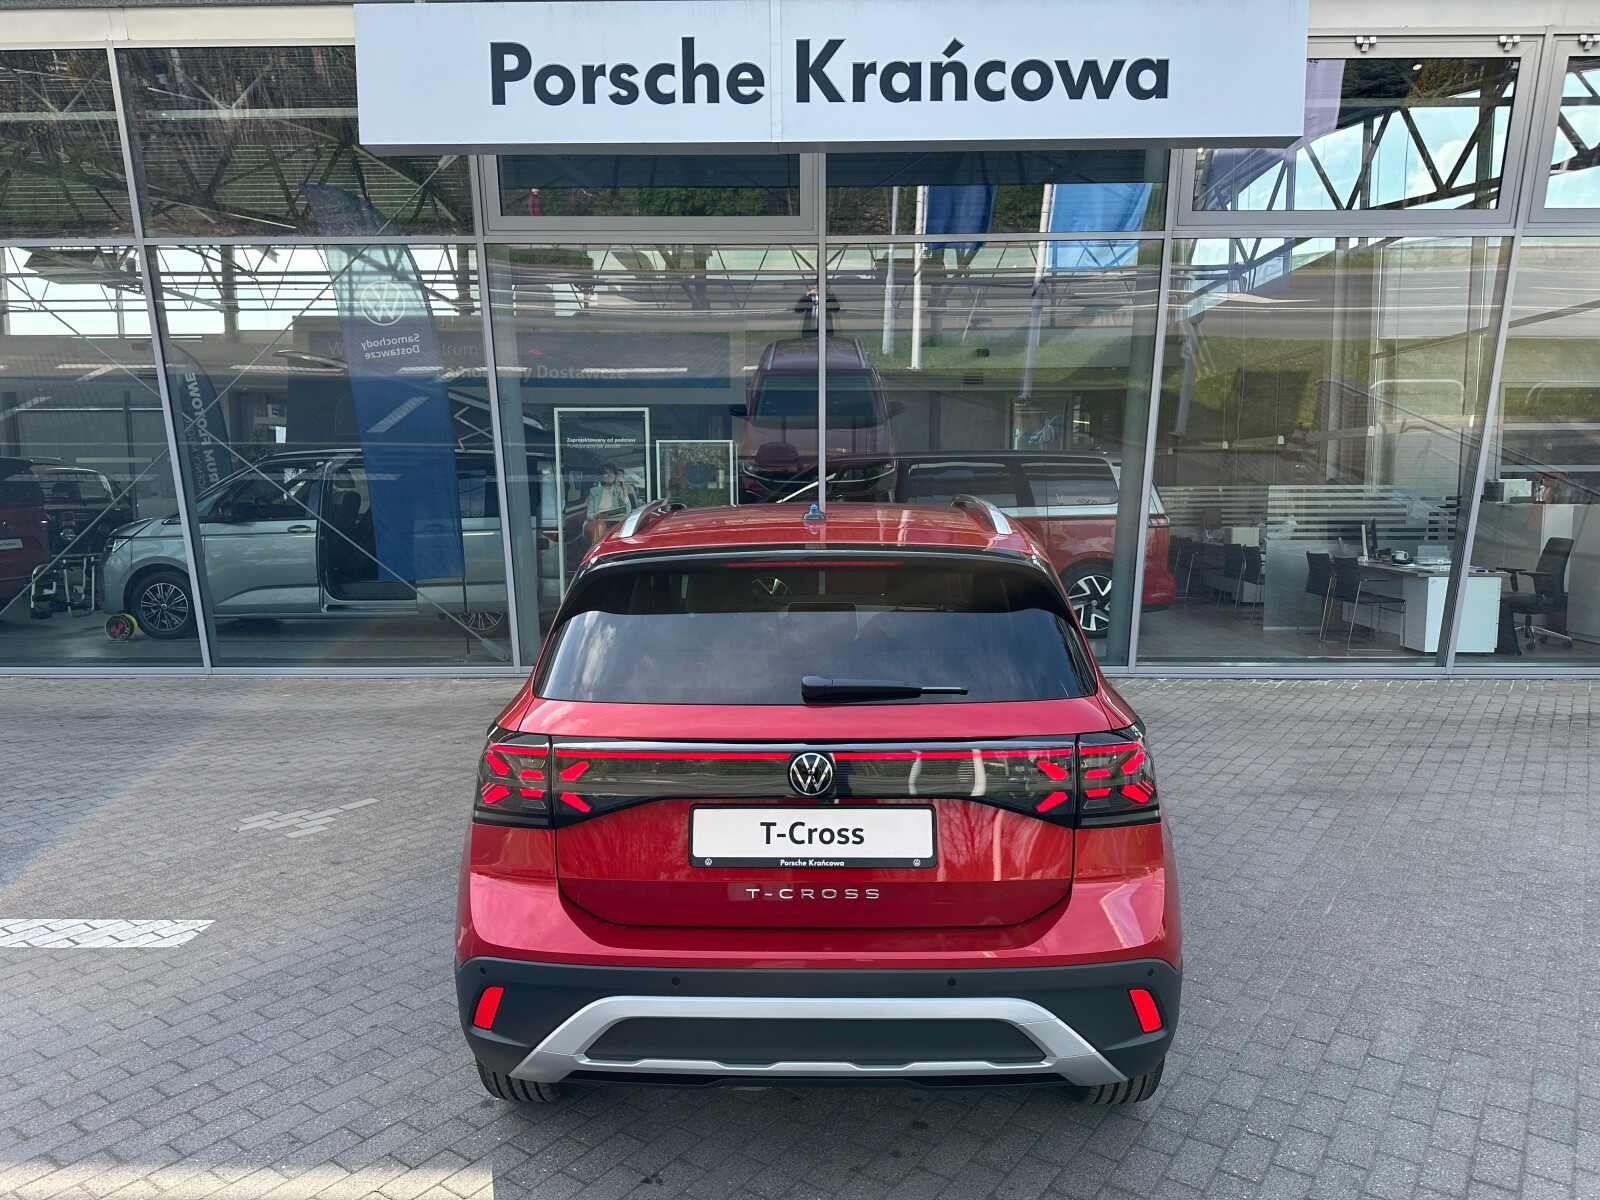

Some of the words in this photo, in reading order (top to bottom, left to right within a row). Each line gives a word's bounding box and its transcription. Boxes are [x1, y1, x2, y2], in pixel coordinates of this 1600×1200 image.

[491, 37, 764, 105] Porsche
[797, 39, 1169, 103] Krańcowa
[761, 822, 864, 844] T-Cross
[780, 858, 807, 867] Porsche
[808, 858, 845, 867] Krańcowa
[746, 889, 879, 899] T-CROSS
